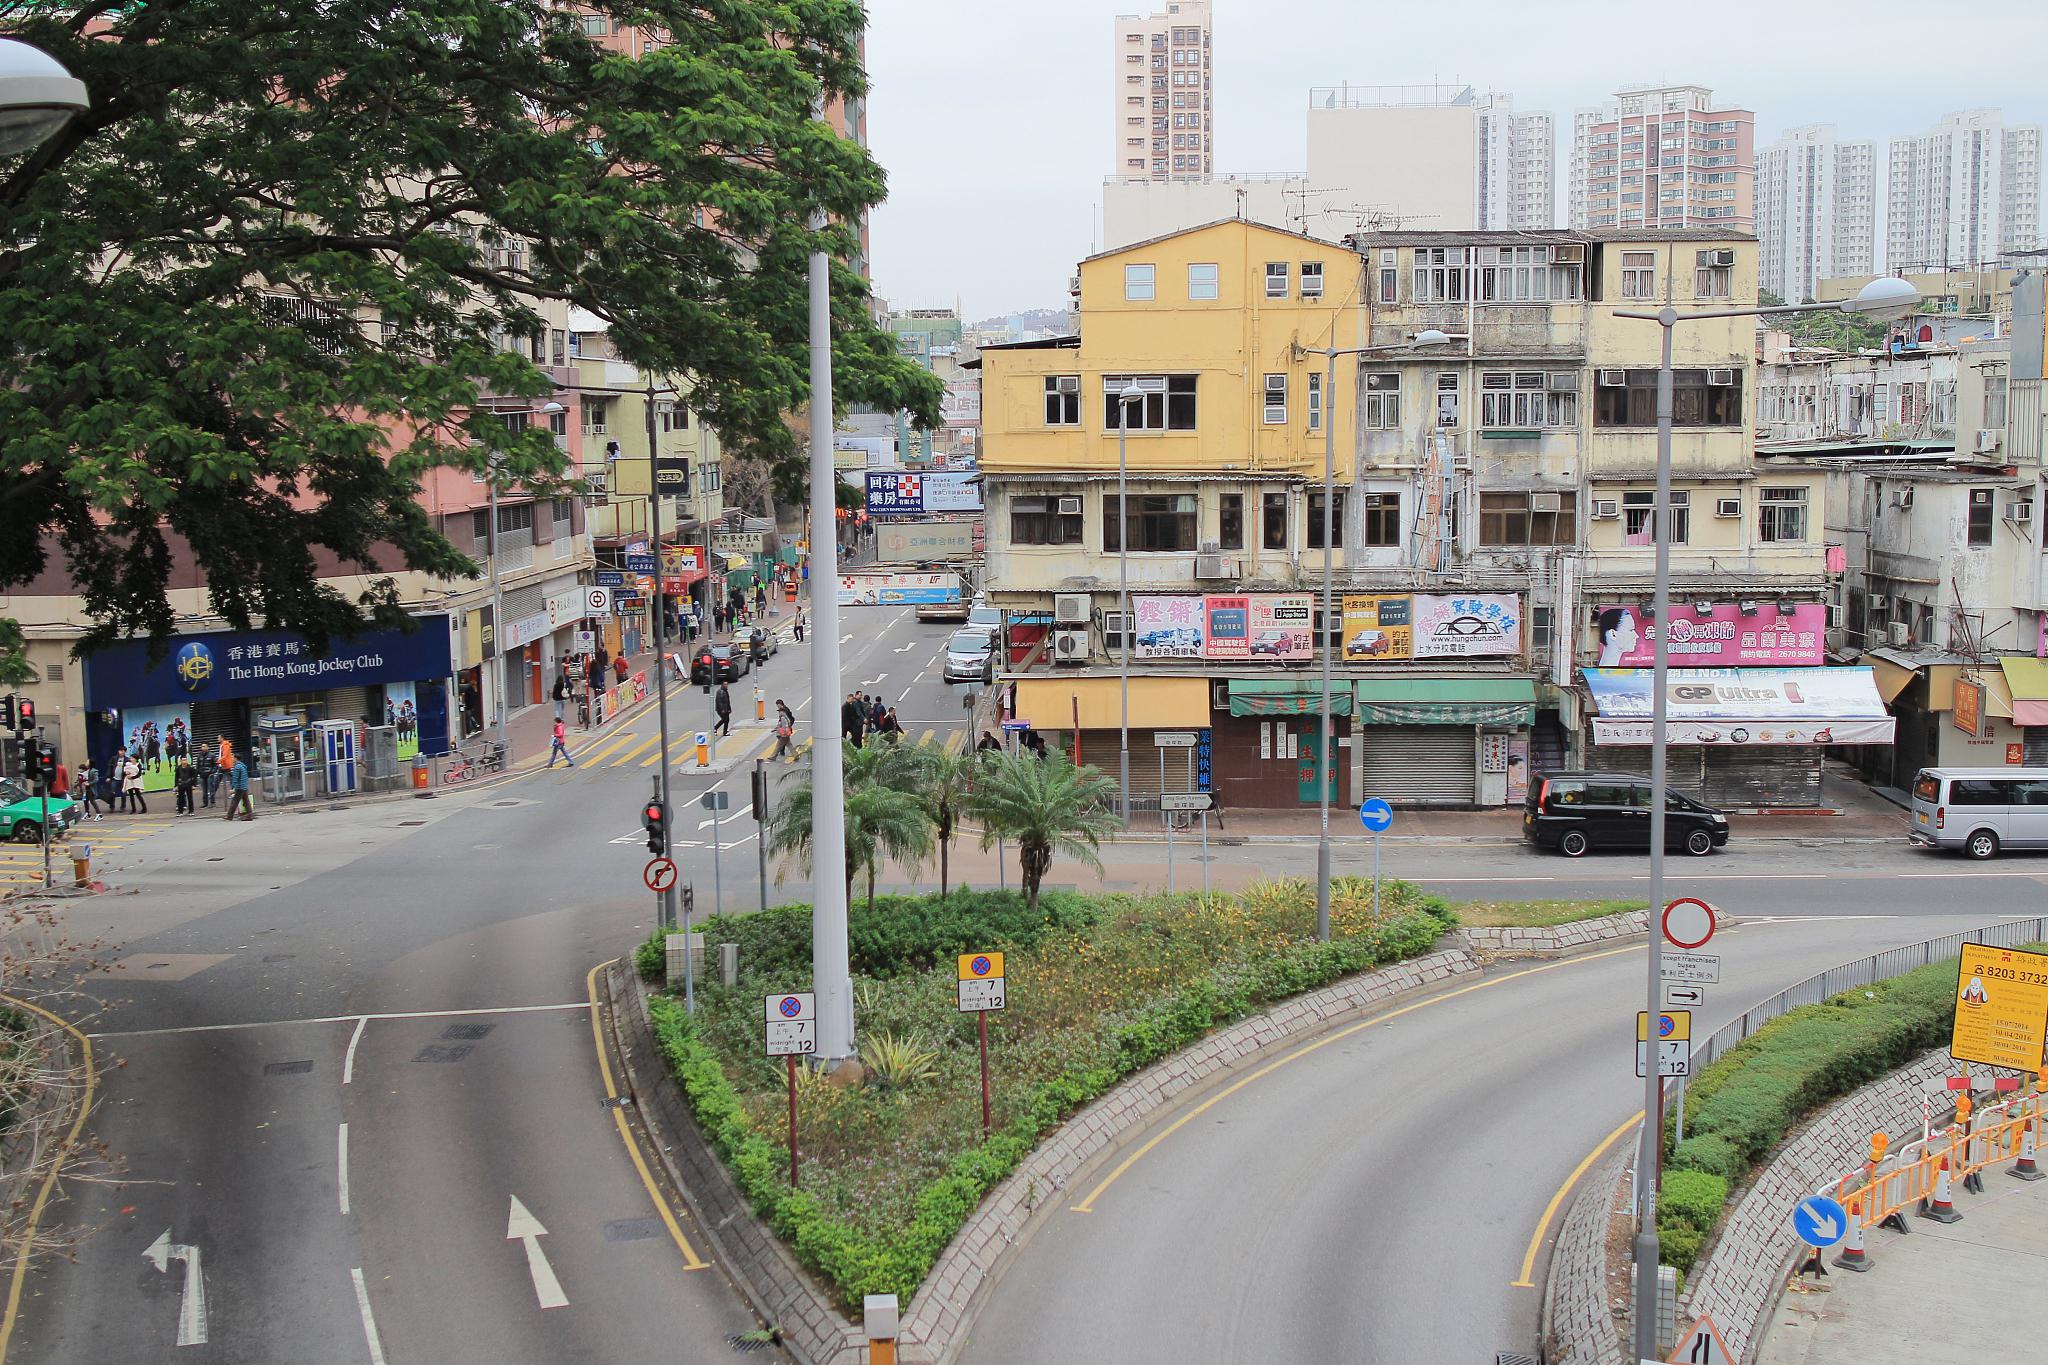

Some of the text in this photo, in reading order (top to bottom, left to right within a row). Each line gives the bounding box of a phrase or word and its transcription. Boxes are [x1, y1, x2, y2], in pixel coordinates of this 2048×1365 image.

[870, 475, 897, 489] 回春
[870, 491, 897, 505] 藥房
[1137, 600, 1203, 624] 鏗鏘
[1431, 635, 1504, 643] www.hungchun.com
[227, 641, 316, 661] 香港賽馬
[229, 654, 383, 680] The Hong Kong Jockey Club
[1675, 686, 1778, 699] GP Ultra
[1682, 956, 1717, 964] franchised
[1987, 966, 2048, 985] 8203 3732
[988, 980, 995, 990] 7
[989, 997, 1002, 1007] 12
[797, 1022, 805, 1033] 7
[798, 1040, 812, 1051] 12
[1670, 1042, 1678, 1054] 7
[1670, 1061, 1685, 1073] 12
